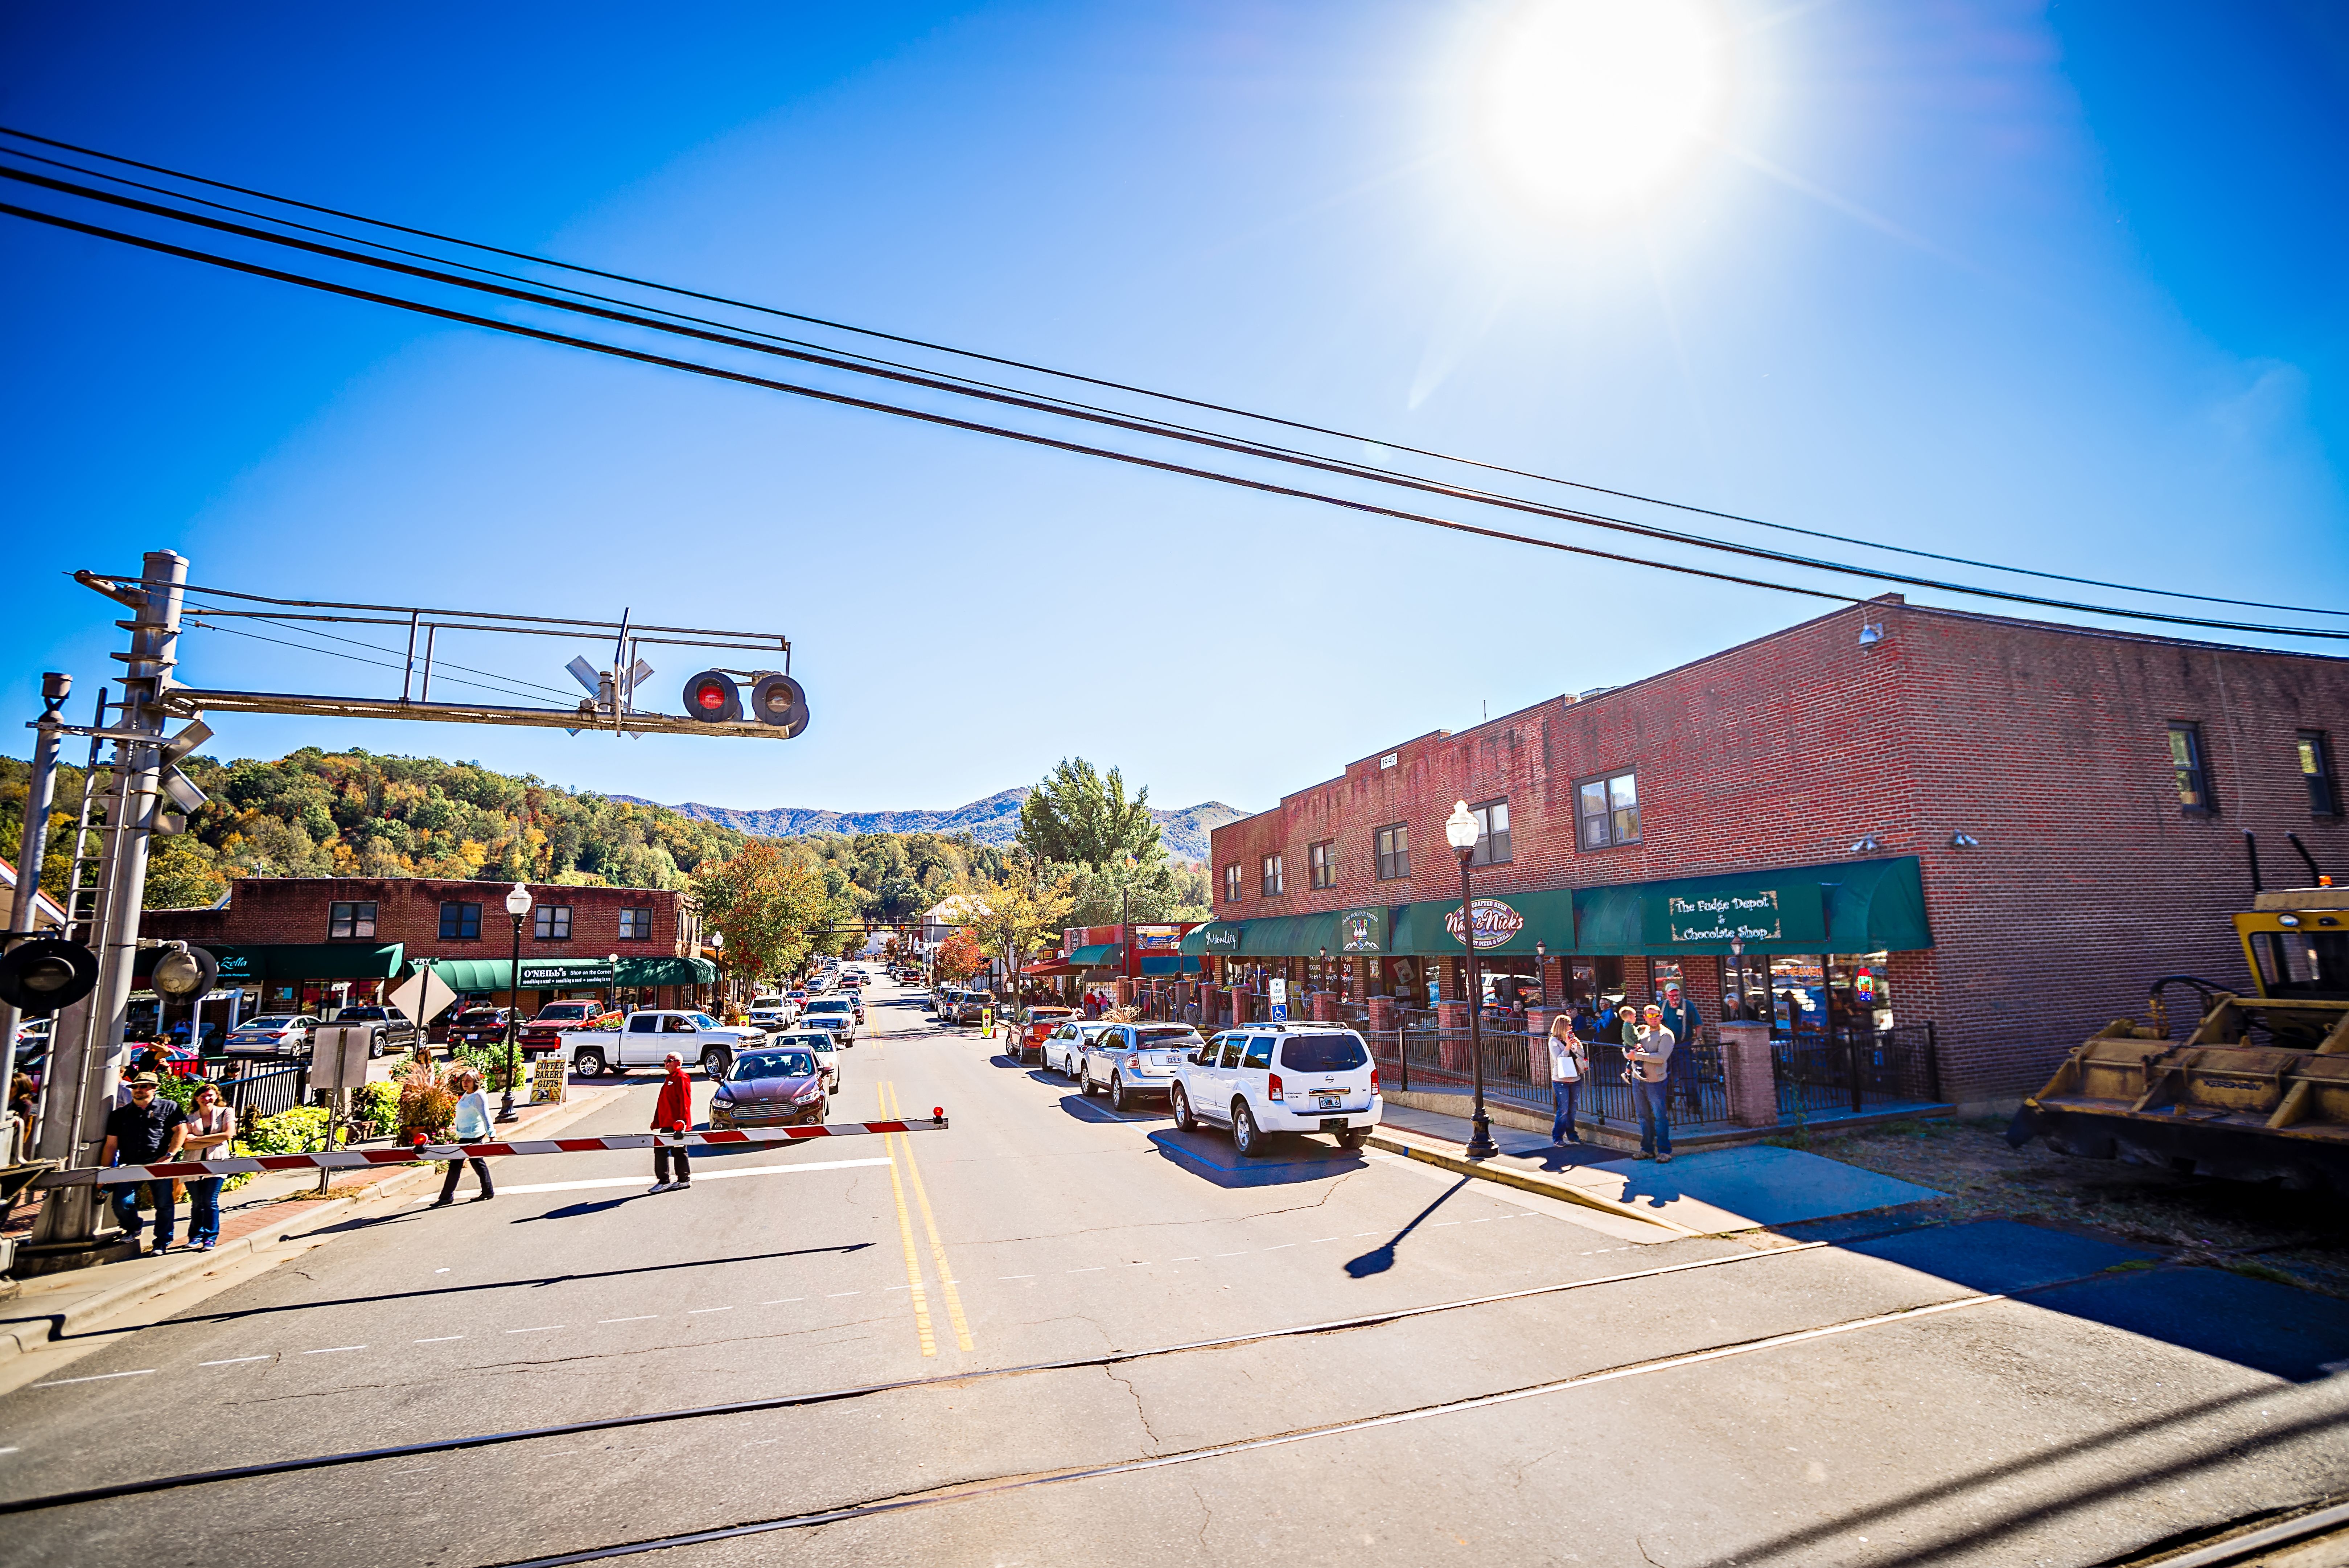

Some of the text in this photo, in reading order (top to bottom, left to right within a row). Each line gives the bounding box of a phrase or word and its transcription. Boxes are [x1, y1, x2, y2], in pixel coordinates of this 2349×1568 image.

[1494, 902, 1507, 912] BEER
[1675, 897, 1769, 913] The Fudge Depot
[1349, 919, 1371, 928] YOGURT
[1476, 917, 1484, 929] &
[1484, 909, 1523, 931] Nick's
[1717, 914, 1726, 925] &
[1497, 933, 1510, 942] GRILL
[1683, 925, 1768, 940] Chocolate Shop
[221, 957, 247, 970] Zella
[1343, 964, 1351, 972] 50
